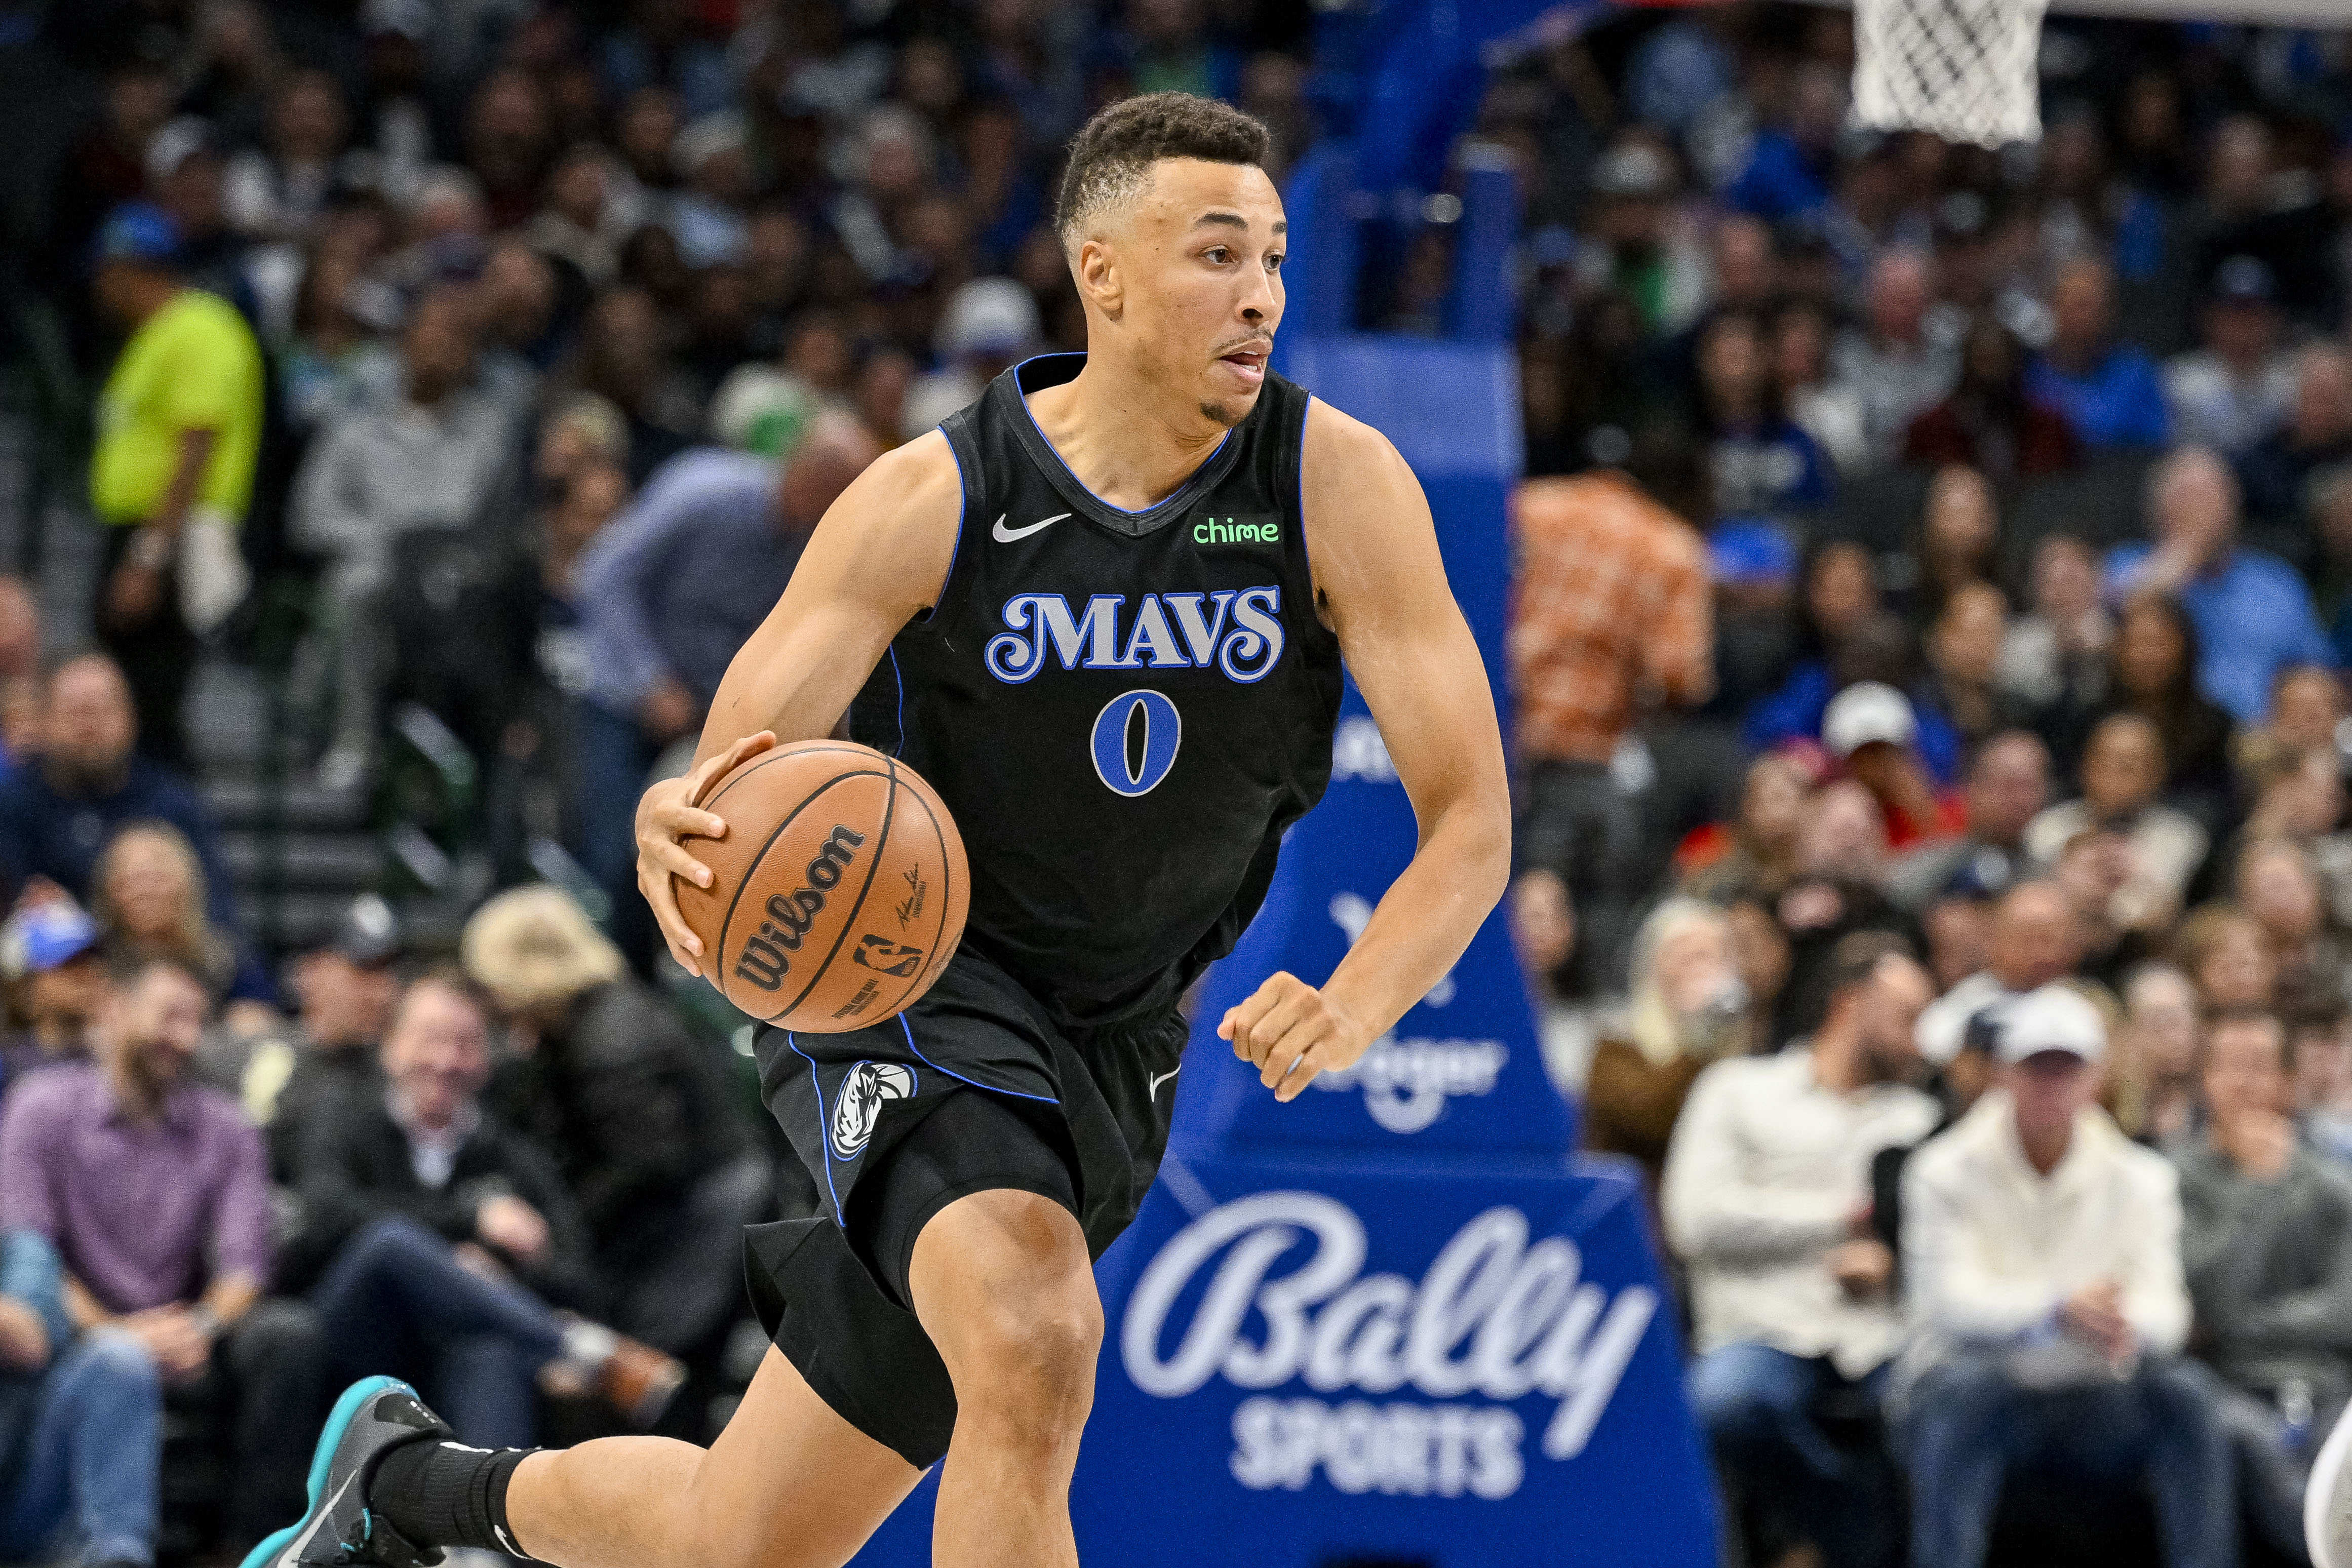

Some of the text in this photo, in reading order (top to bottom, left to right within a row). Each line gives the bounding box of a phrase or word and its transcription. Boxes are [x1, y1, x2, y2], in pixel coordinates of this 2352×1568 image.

[1194, 518, 1279, 544] chime
[985, 584, 1285, 684] MAVS
[1090, 689, 1182, 797] 0
[734, 824, 866, 992] Wilson
[1119, 1188, 1659, 1461] Bally
[1229, 1394, 1525, 1501] SPORTS
